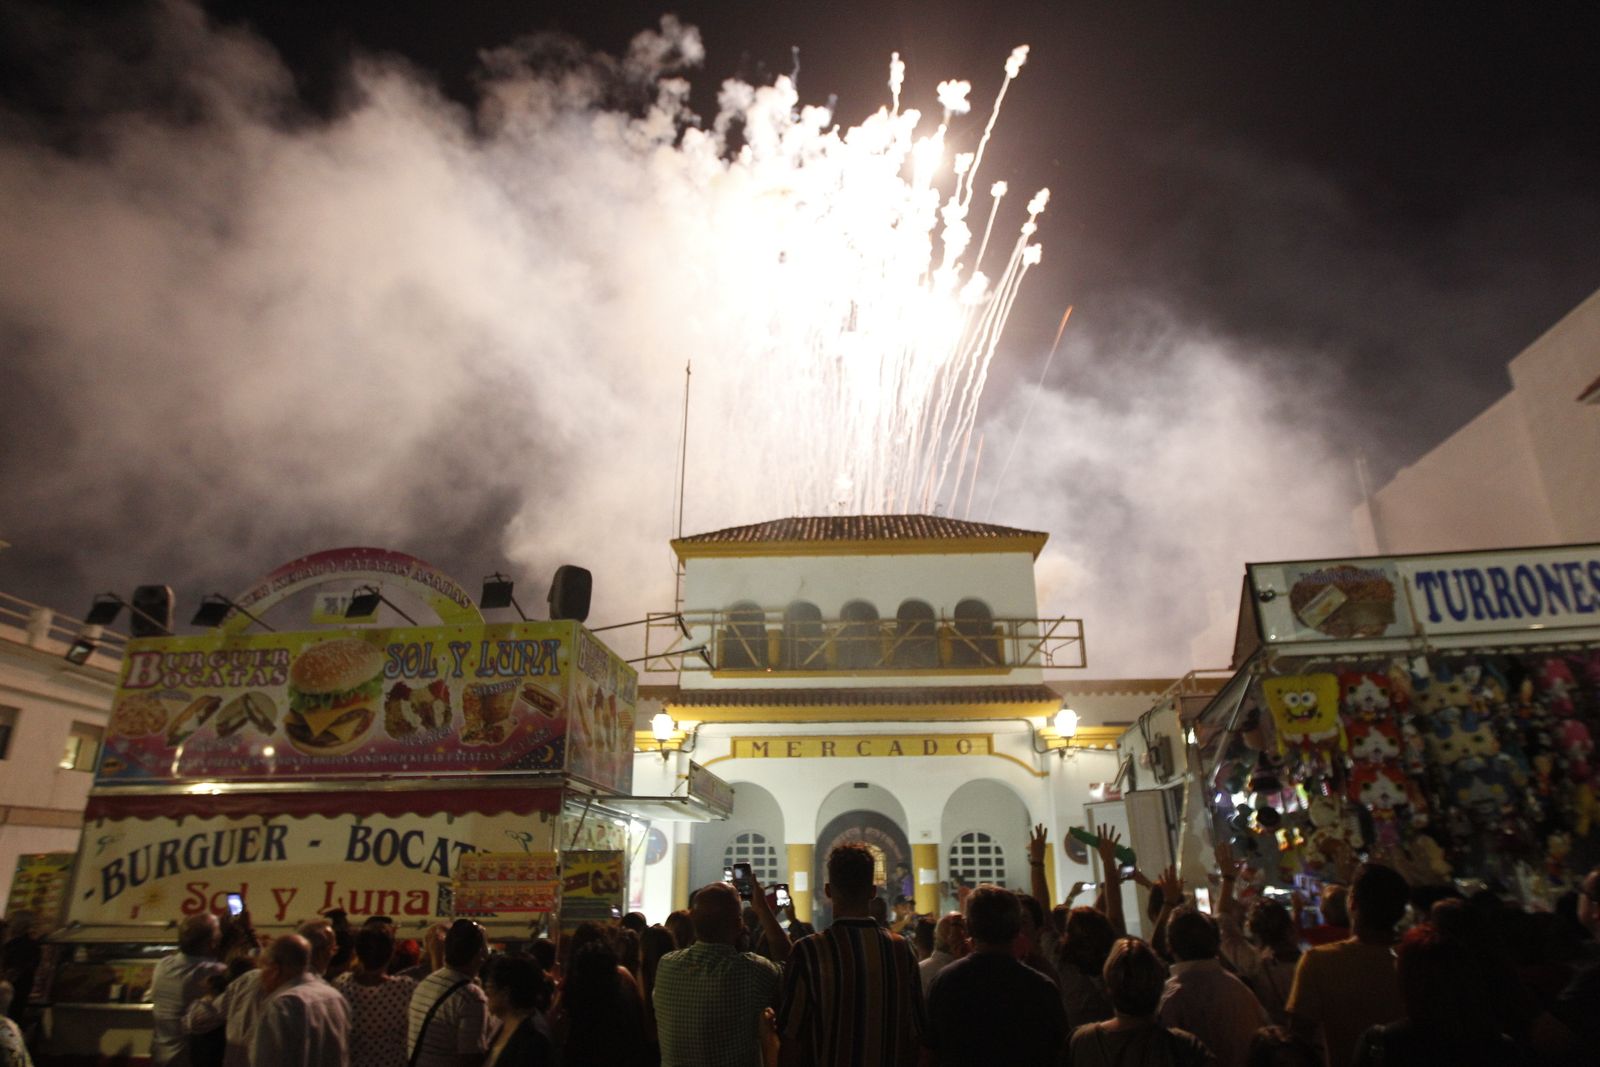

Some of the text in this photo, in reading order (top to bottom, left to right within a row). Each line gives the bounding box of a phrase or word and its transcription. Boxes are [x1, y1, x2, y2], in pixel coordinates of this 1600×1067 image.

[383, 642, 438, 679] SOL
[448, 641, 472, 678] Y
[475, 638, 562, 678] LUNA
[751, 738, 974, 758] MERCADO
[101, 824, 289, 905] BURGUER
[345, 824, 491, 879] BOCAT
[317, 880, 430, 917] Luna
